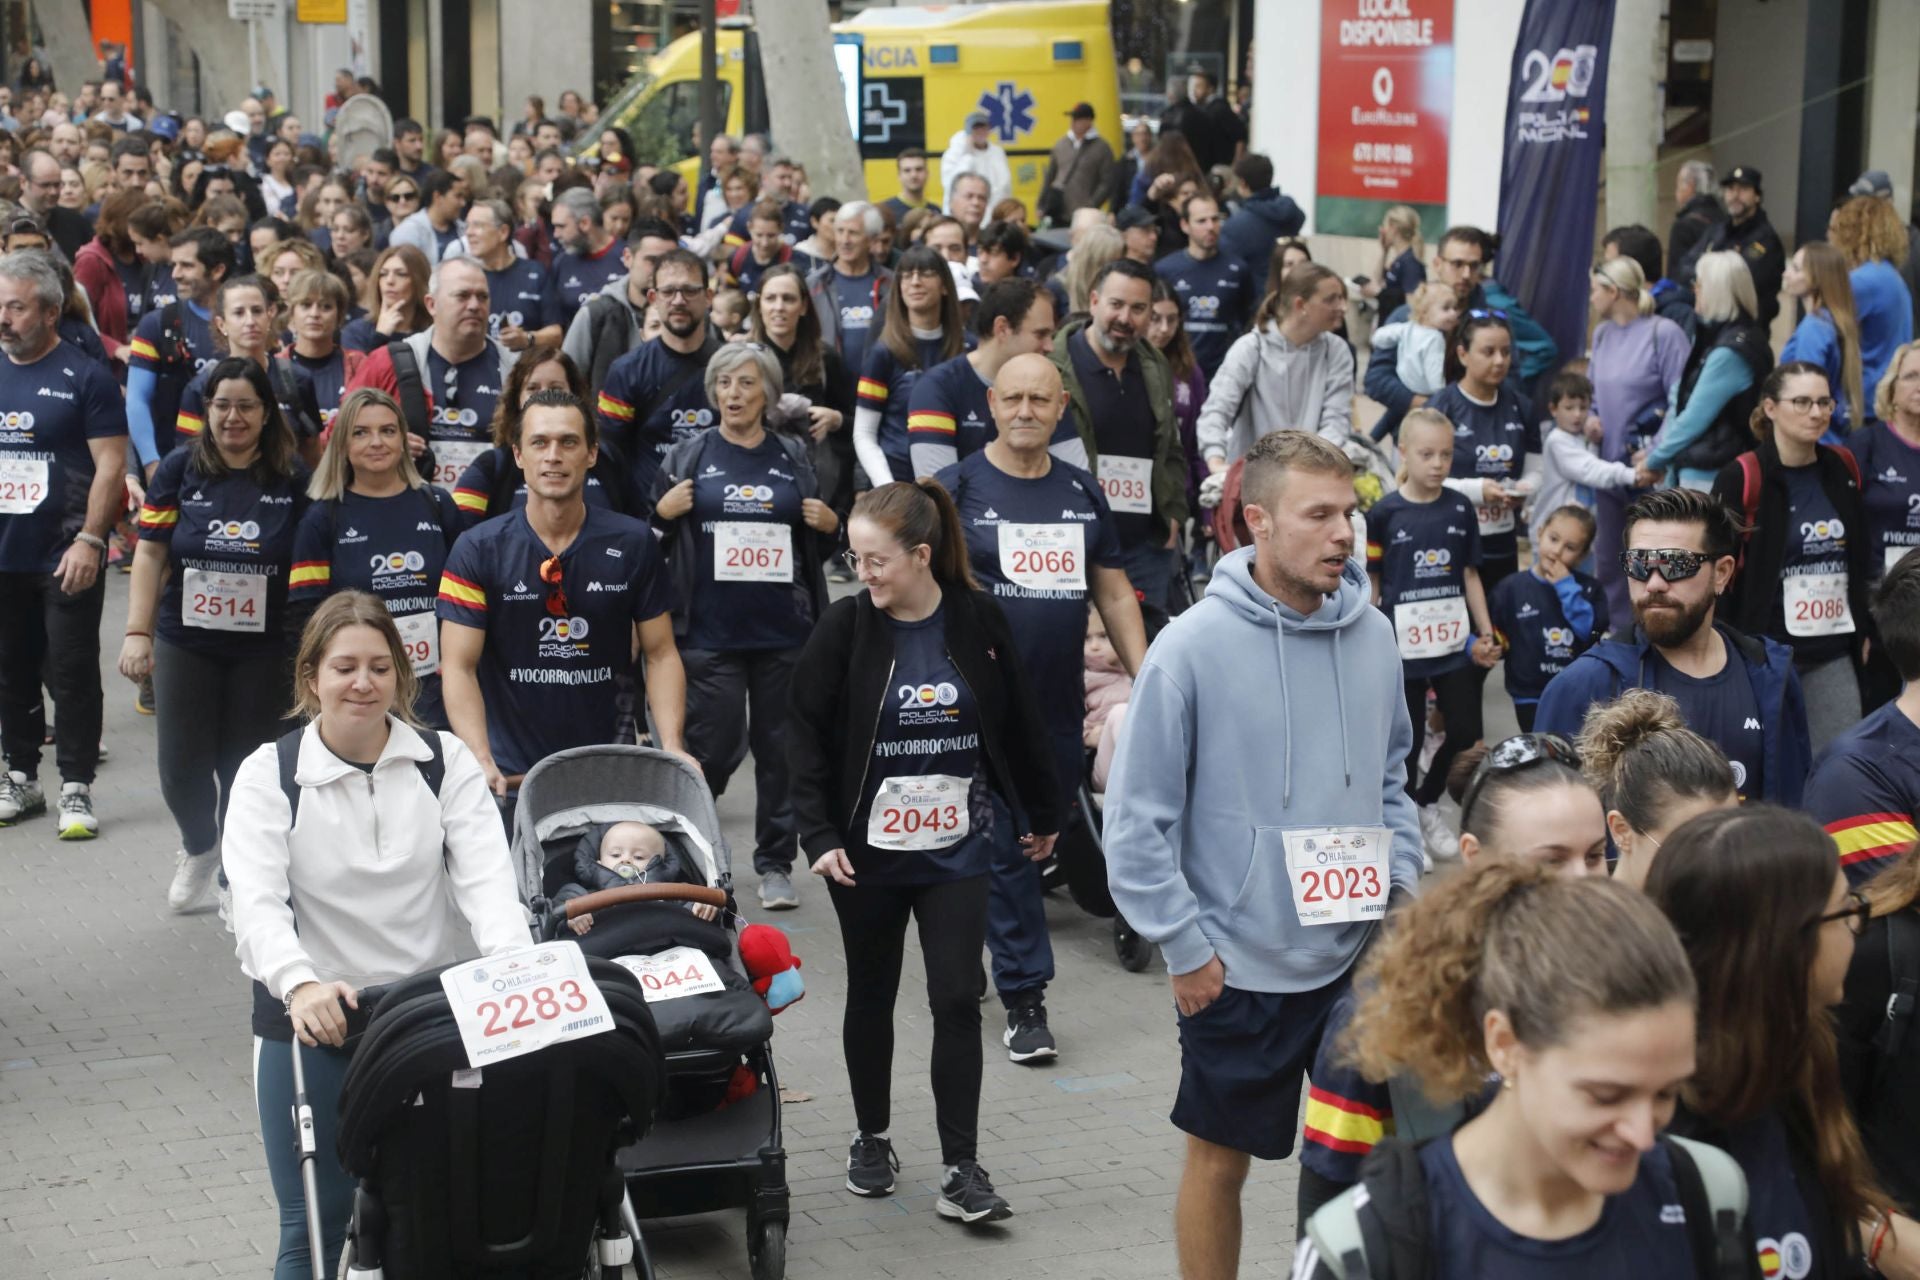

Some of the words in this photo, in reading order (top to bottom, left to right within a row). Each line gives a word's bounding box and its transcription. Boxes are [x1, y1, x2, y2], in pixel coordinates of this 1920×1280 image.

[1358, 0, 1411, 17] LOCAL
[1340, 19, 1433, 46] DISPONIBLE
[671, 409, 713, 428] 200
[1475, 444, 1513, 461] 200
[0, 482, 41, 500] 212
[723, 484, 774, 502] 200
[208, 520, 260, 540] 200
[1800, 518, 1845, 543] 200
[370, 551, 425, 576] 200
[726, 547, 784, 568] 2067
[1012, 551, 1075, 573] 2066
[1413, 549, 1452, 569] 200
[371, 574, 416, 584] POLICIA
[503, 593, 539, 601] Santander
[604, 582, 628, 593] mupol
[193, 593, 256, 617] 2514
[1795, 598, 1844, 620] 2086
[538, 616, 590, 643] 200
[1407, 621, 1461, 645] 3157
[539, 643, 577, 652] POLICIA
[510, 667, 612, 686] #YOCORROCONLUCA
[899, 682, 958, 709] 200
[899, 709, 947, 719] POLICIA
[899, 716, 959, 726] NACIONAL
[876, 733, 979, 757] #YOCORROCONLUCA
[883, 805, 958, 833] 2043
[1300, 866, 1381, 903] 2023
[477, 980, 588, 1037] 2283
[561, 1015, 604, 1033] #RUTA091
